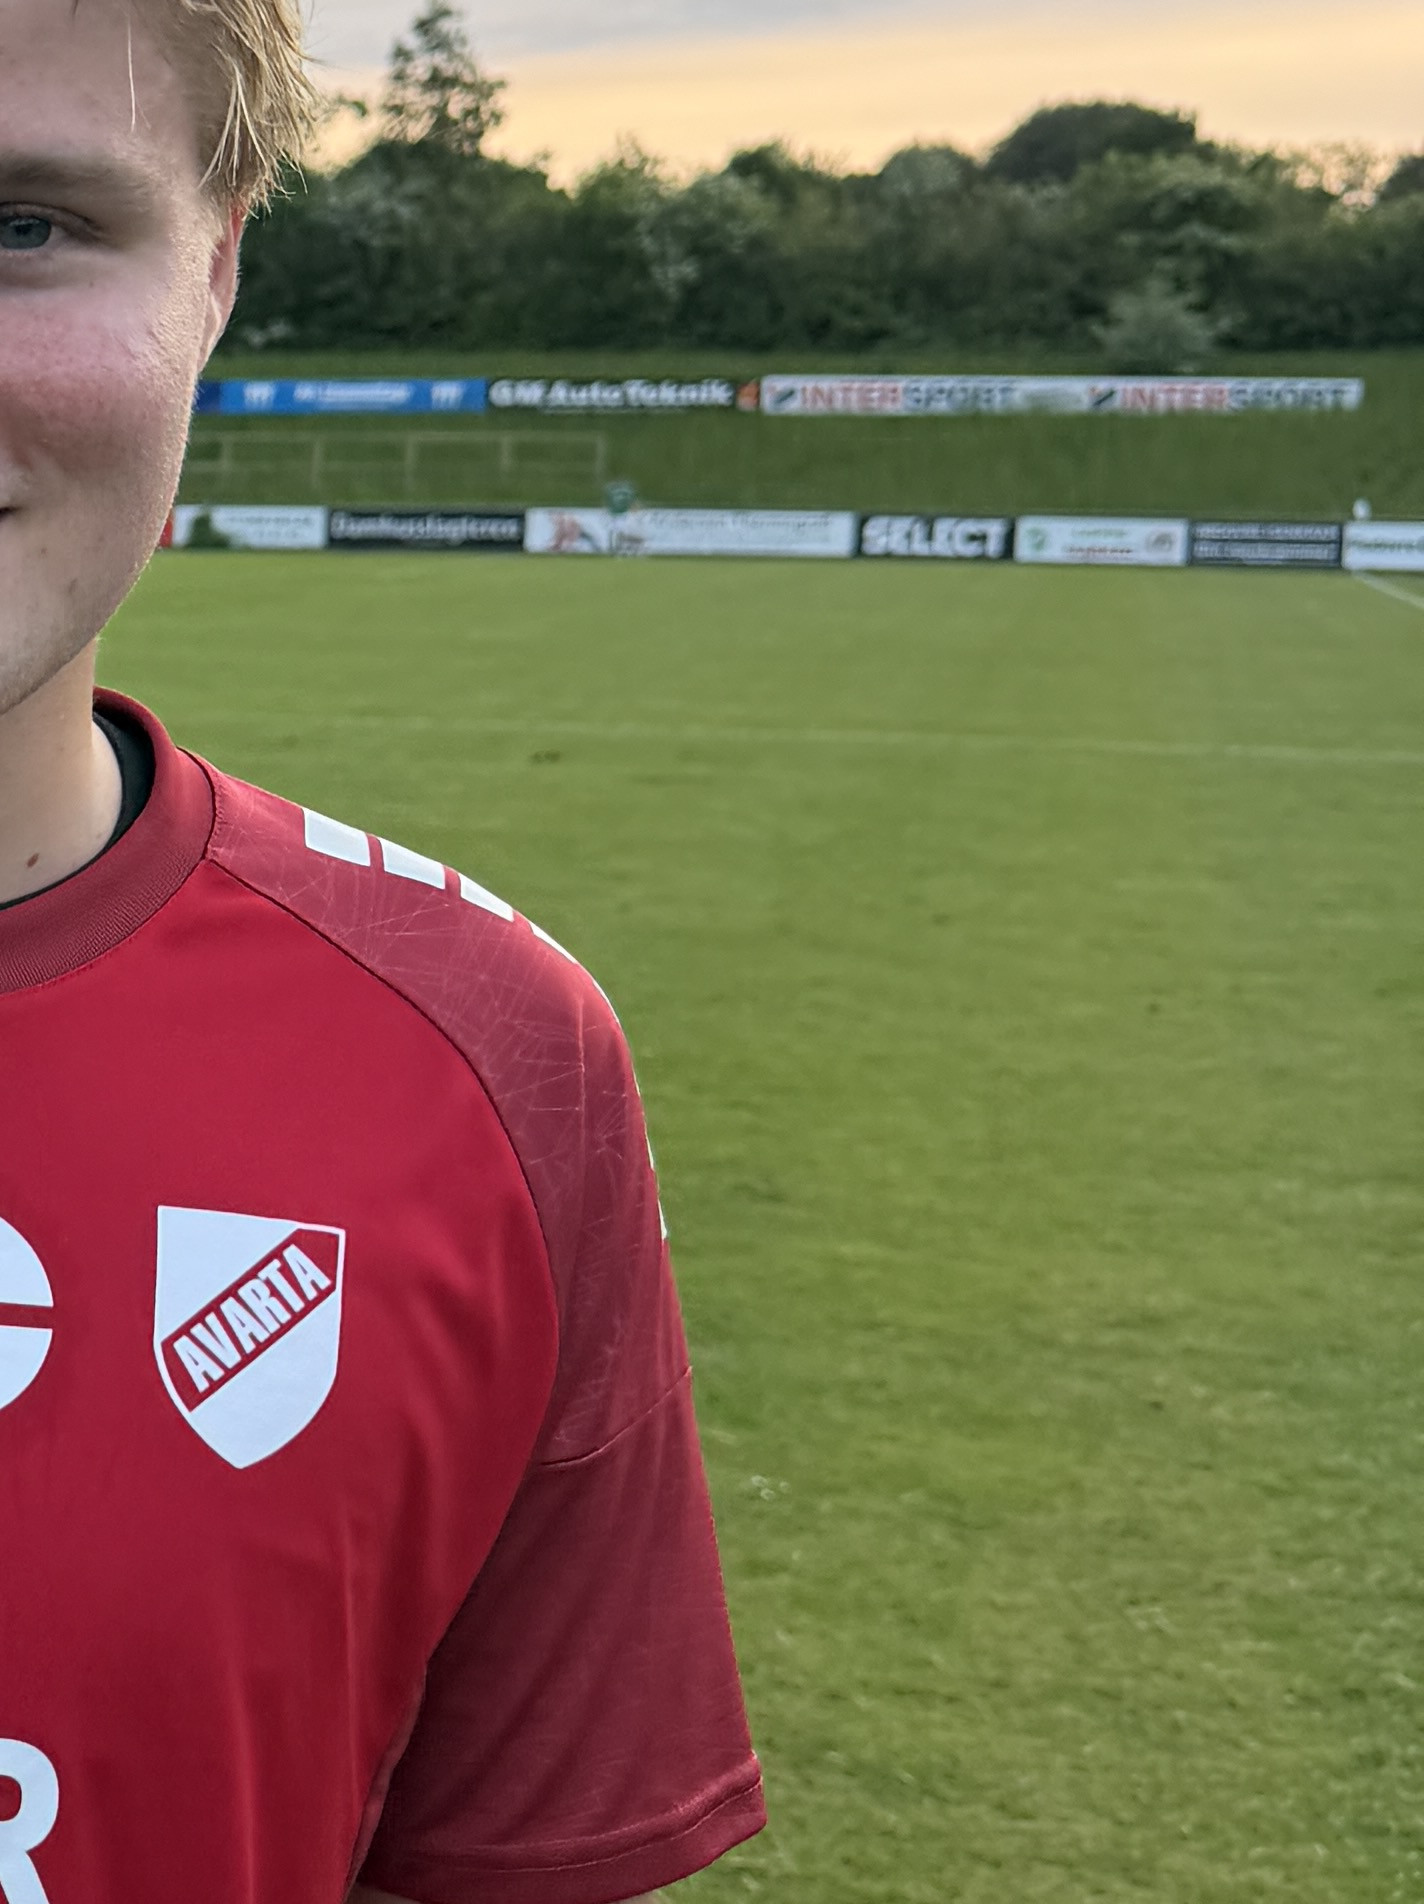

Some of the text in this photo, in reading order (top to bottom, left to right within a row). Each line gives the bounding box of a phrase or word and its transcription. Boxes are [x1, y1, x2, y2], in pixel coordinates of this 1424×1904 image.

[800, 383, 1017, 411] INTERSPORT
[1122, 385, 1346, 412] INTERSPORT
[861, 515, 1009, 559] SELECT
[170, 1242, 330, 1393] AVARTA
